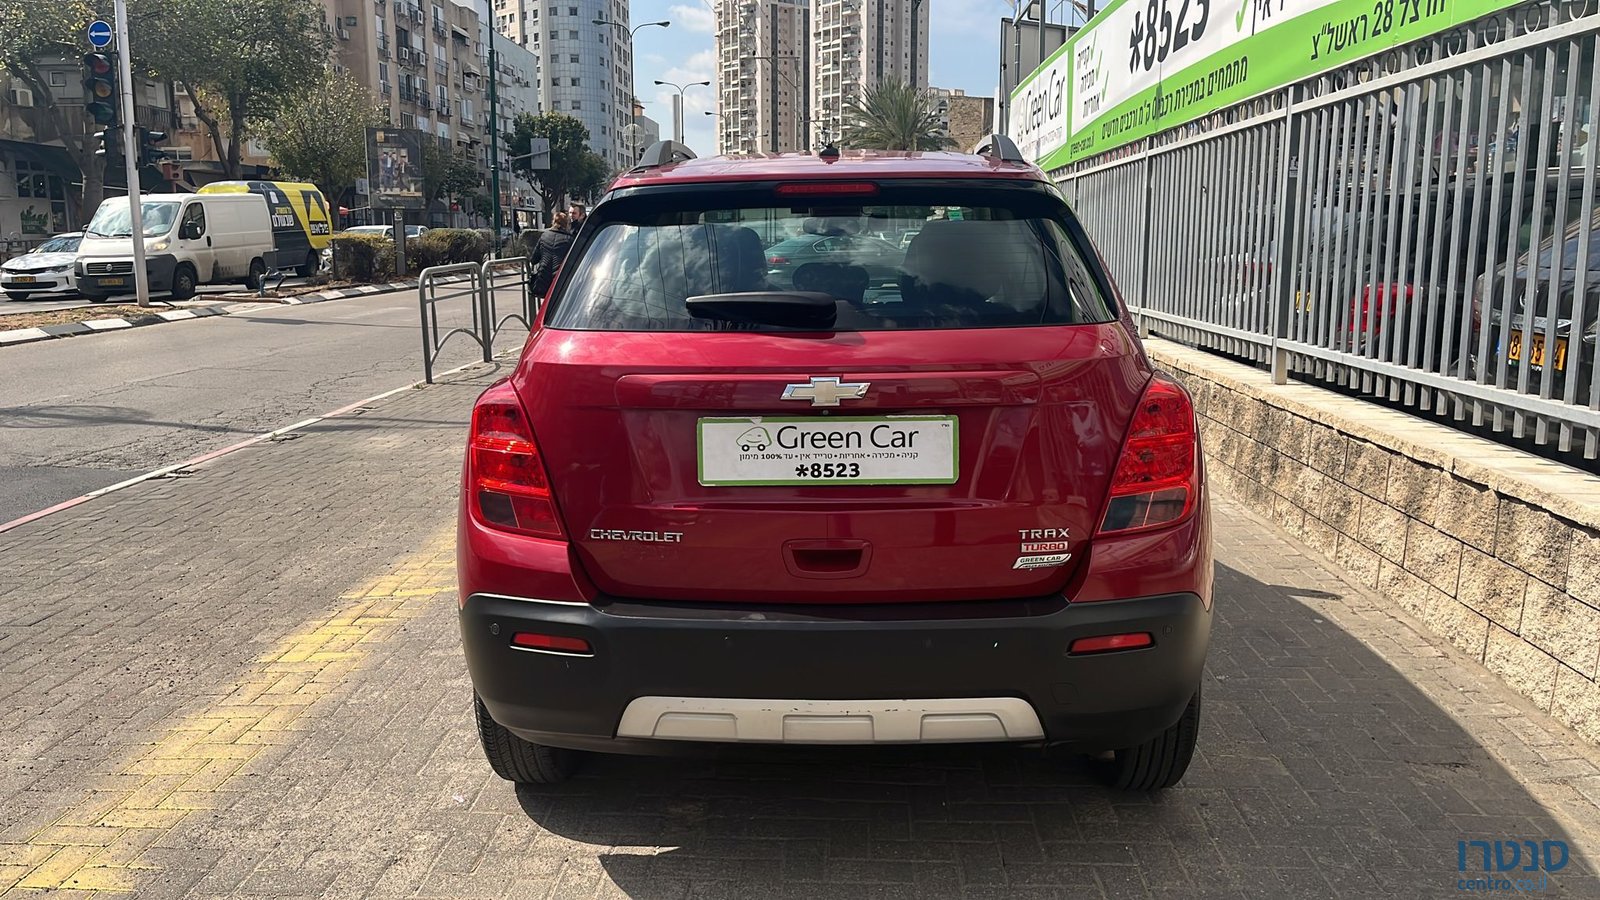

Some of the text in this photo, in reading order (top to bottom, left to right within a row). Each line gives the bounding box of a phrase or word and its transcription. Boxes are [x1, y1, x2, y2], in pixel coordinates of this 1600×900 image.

[1372, 0, 1394, 37] 28
[1207, 55, 1248, 96] מתמחים
[1048, 68, 1066, 121] Car
[1174, 77, 1205, 112] במכירת
[776, 424, 919, 449] Green Car
[739, 453, 759, 461] מימון
[800, 453, 811, 461] אין
[839, 452, 866, 460] אחריות
[872, 452, 895, 460] מכירה
[901, 452, 919, 460] קניה
[590, 528, 683, 543] CHEVROLET
[1018, 527, 1070, 540] TRAX
[1023, 542, 1066, 552] TURBO
